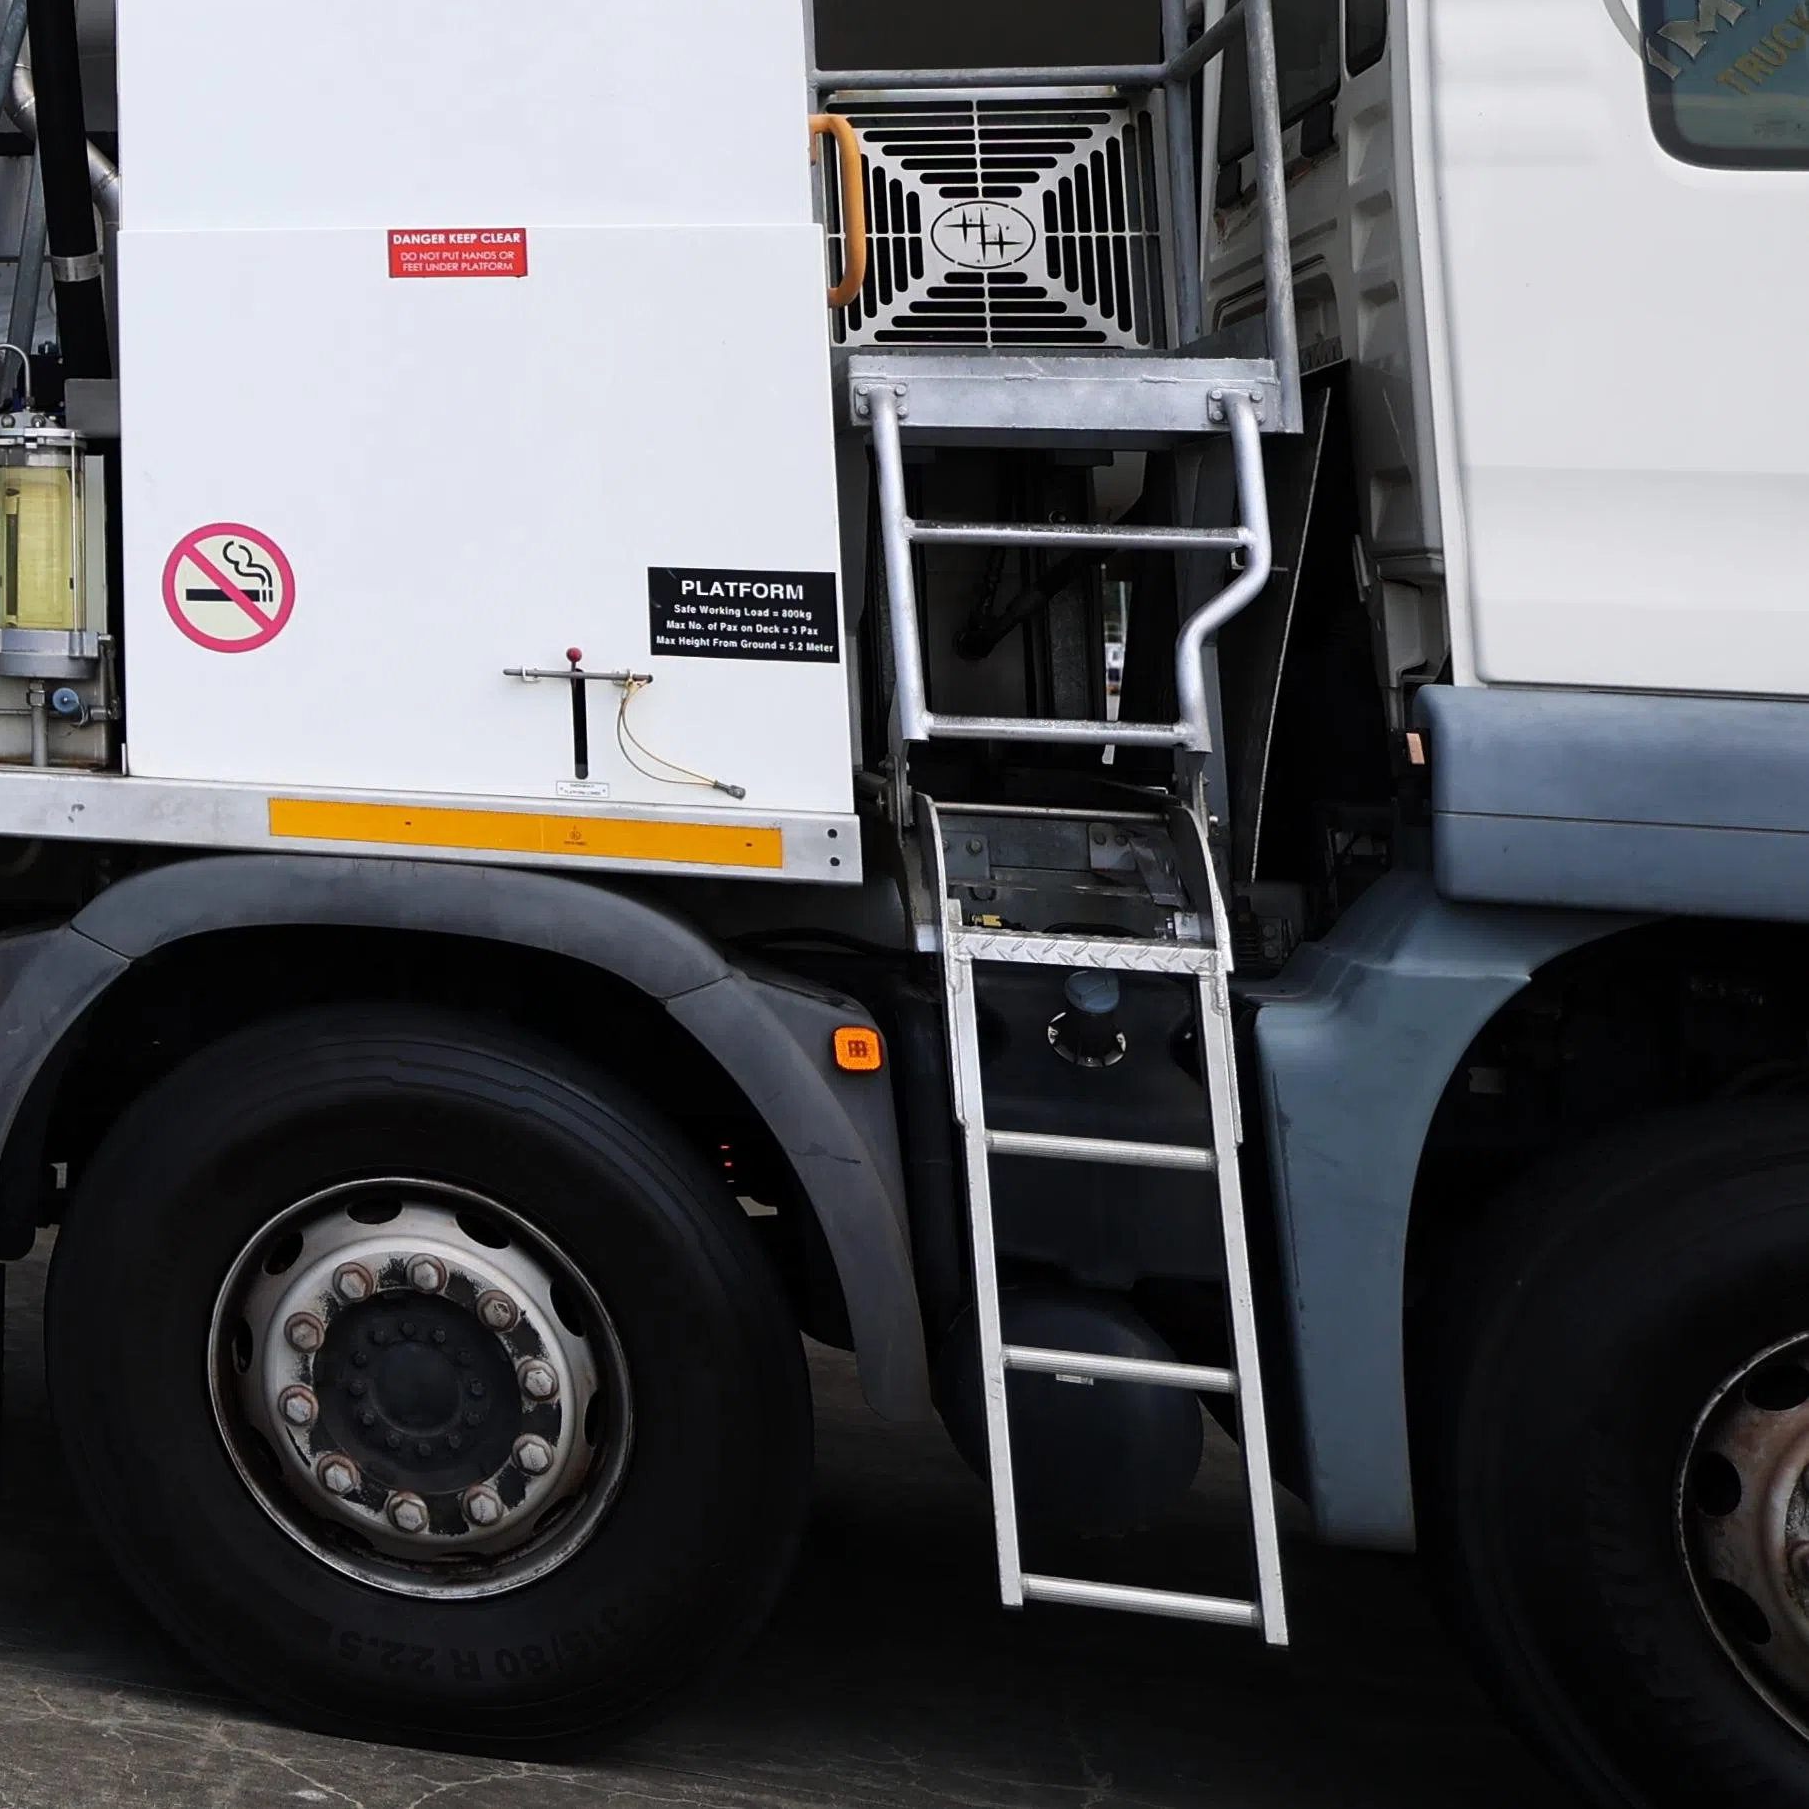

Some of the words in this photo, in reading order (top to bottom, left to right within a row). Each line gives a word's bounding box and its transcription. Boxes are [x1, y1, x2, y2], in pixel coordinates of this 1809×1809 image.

[393, 234, 445, 245] DANGER
[449, 234, 478, 245] KEEP
[481, 233, 521, 244] CLEAR
[400, 252, 417, 261] DO
[419, 251, 441, 261] NOT
[442, 251, 460, 261] PUT
[461, 251, 497, 261] HANDS
[499, 251, 515, 260] OR
[402, 263, 423, 272] FEET
[425, 262, 459, 271] UNDER
[460, 262, 514, 271] PLATFORM
[681, 580, 804, 600] PLATFORM
[674, 604, 697, 614] Safe
[699, 605, 741, 618] Working
[743, 606, 770, 617] Load
[666, 619, 685, 630] Max
[688, 620, 704, 631] No.
[707, 622, 717, 631] of
[720, 622, 738, 632] Pax
[741, 624, 753, 633] on
[756, 624, 780, 633] Deck
[791, 625, 798, 634] 3
[800, 626, 819, 635] Pax
[656, 635, 676, 645] Max
[678, 636, 710, 649] Height
[712, 638, 737, 648] From
[740, 639, 777, 650] Ground
[788, 641, 803, 651] 5.2
[805, 642, 834, 653] Meter
